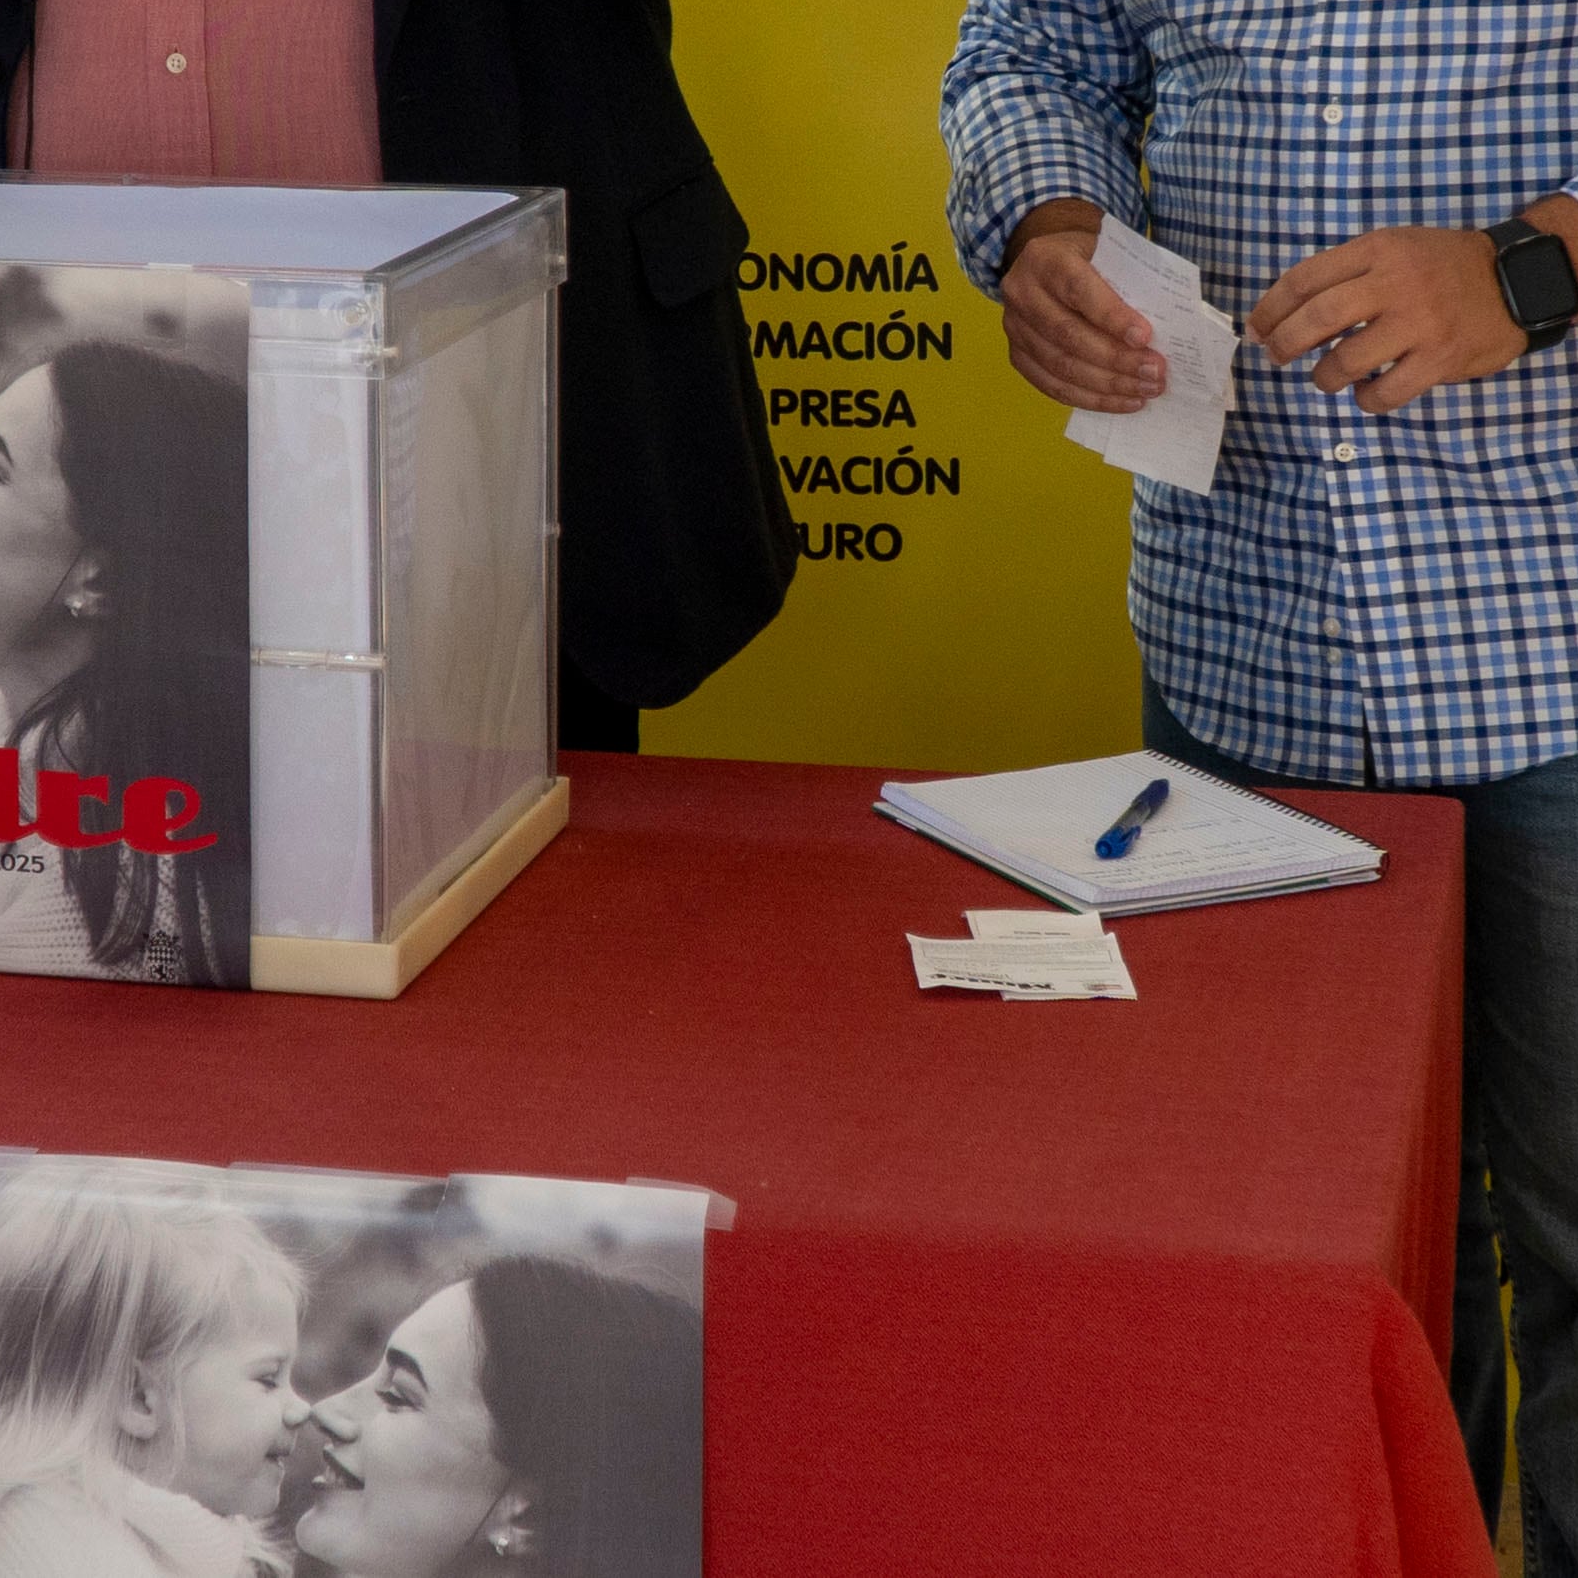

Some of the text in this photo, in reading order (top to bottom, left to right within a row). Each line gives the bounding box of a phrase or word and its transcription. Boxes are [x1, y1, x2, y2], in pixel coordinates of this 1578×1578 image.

[736, 240, 939, 293] ONOMÍA
[753, 309, 953, 361] MACIÓN
[769, 388, 917, 428] PRESA
[779, 445, 960, 496] VACIÓN
[799, 522, 903, 562] URO
